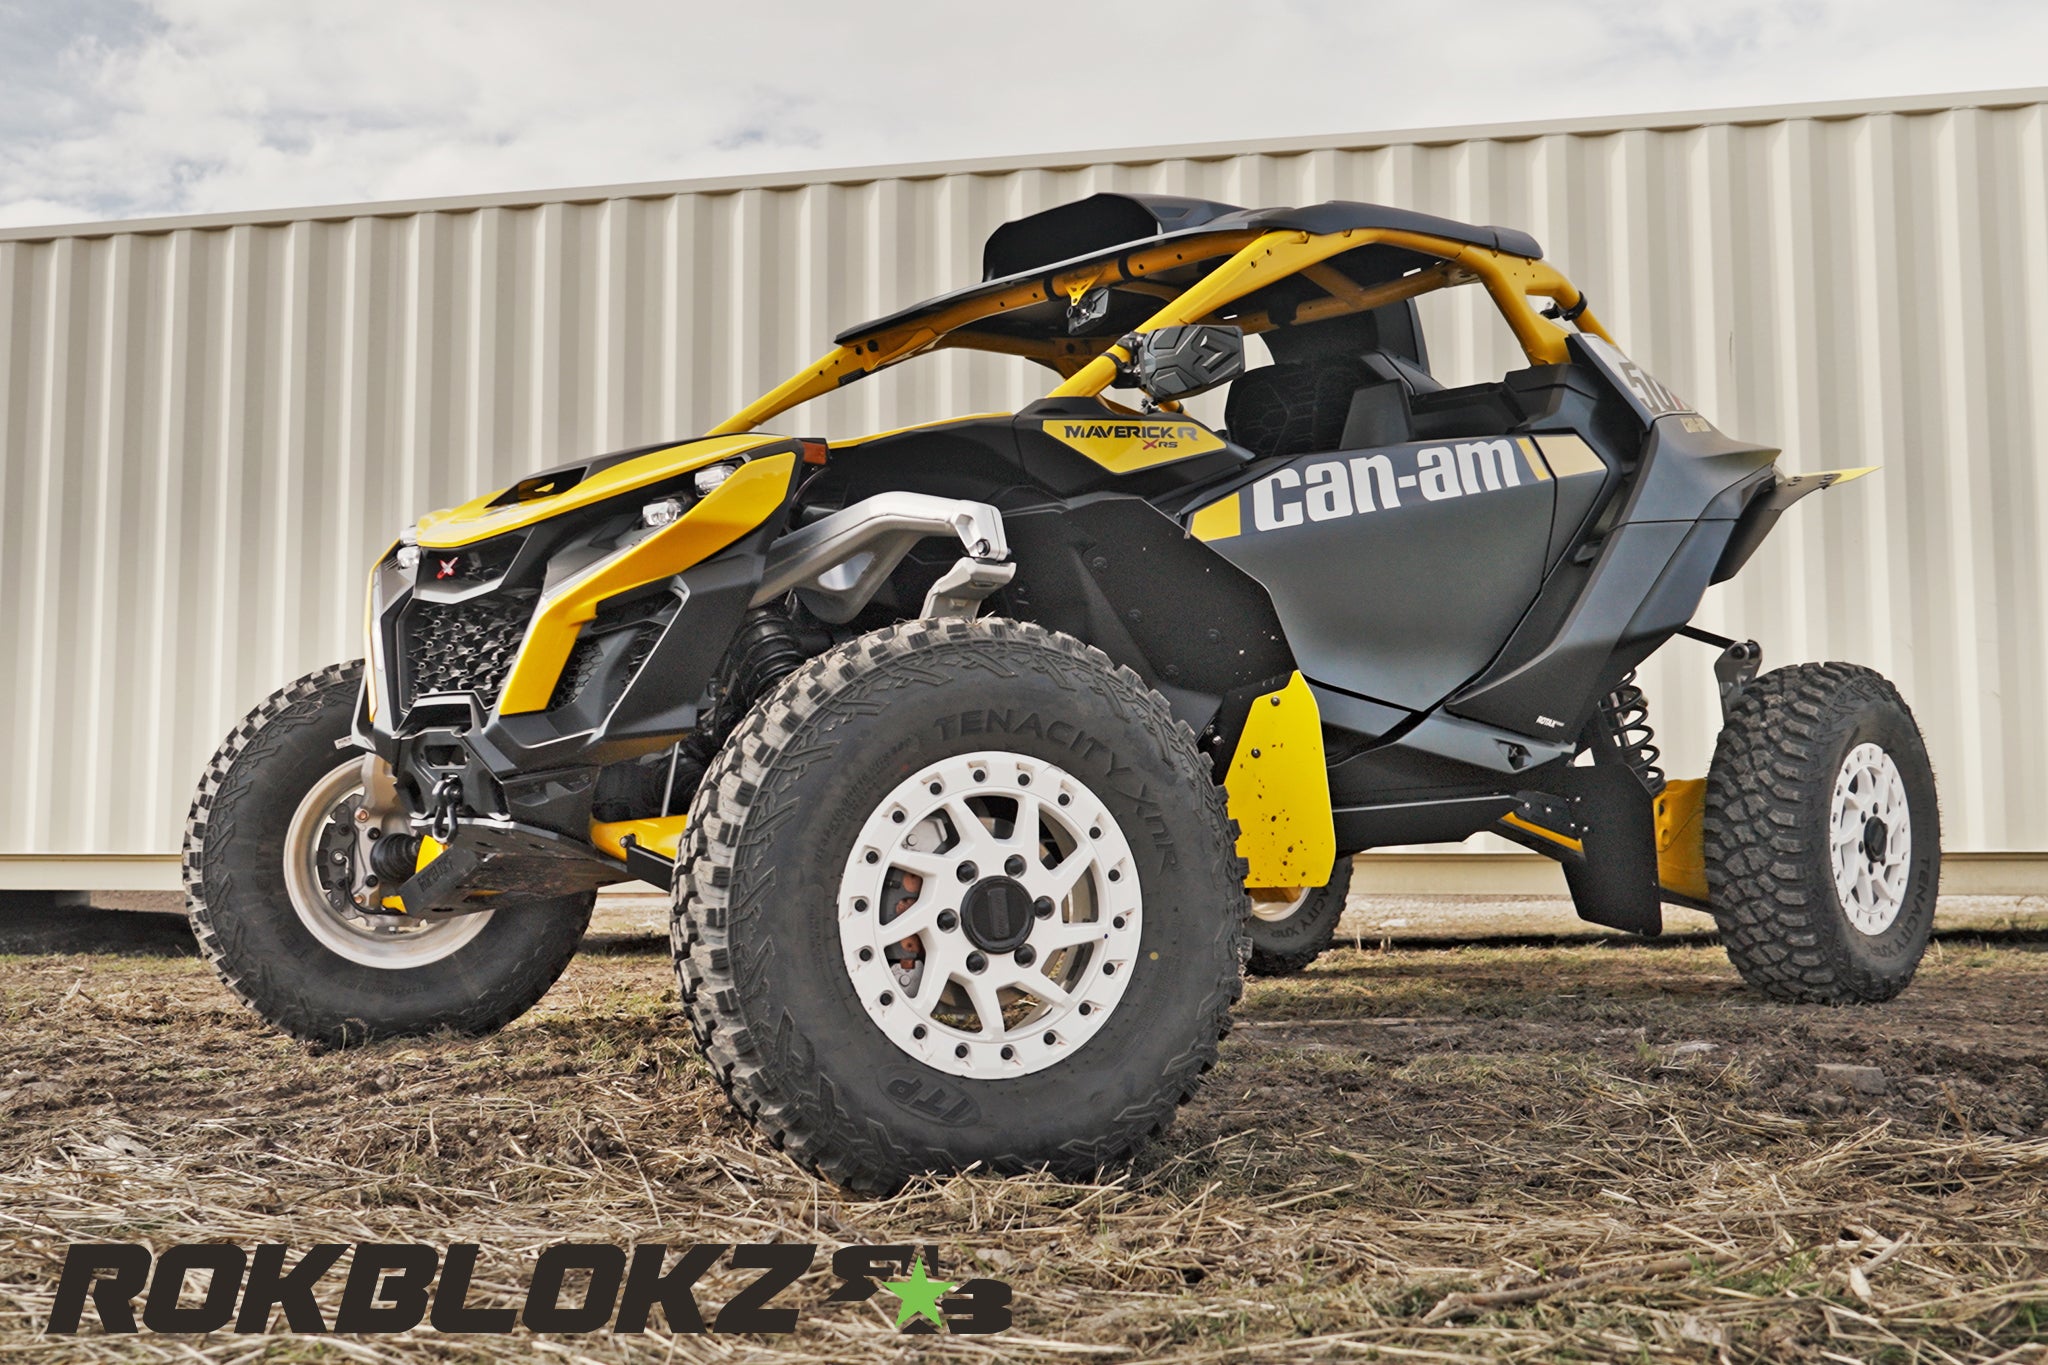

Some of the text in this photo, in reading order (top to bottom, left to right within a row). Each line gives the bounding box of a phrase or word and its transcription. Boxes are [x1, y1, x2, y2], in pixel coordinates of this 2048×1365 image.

[1064, 425, 1198, 441] MAVERICK R
[1142, 439, 1178, 450] XRS
[1253, 439, 1521, 532] can-am
[933, 708, 1133, 777] TENACITY
[1895, 856, 1931, 952] TENACITY
[885, 1078, 971, 1122] ITP
